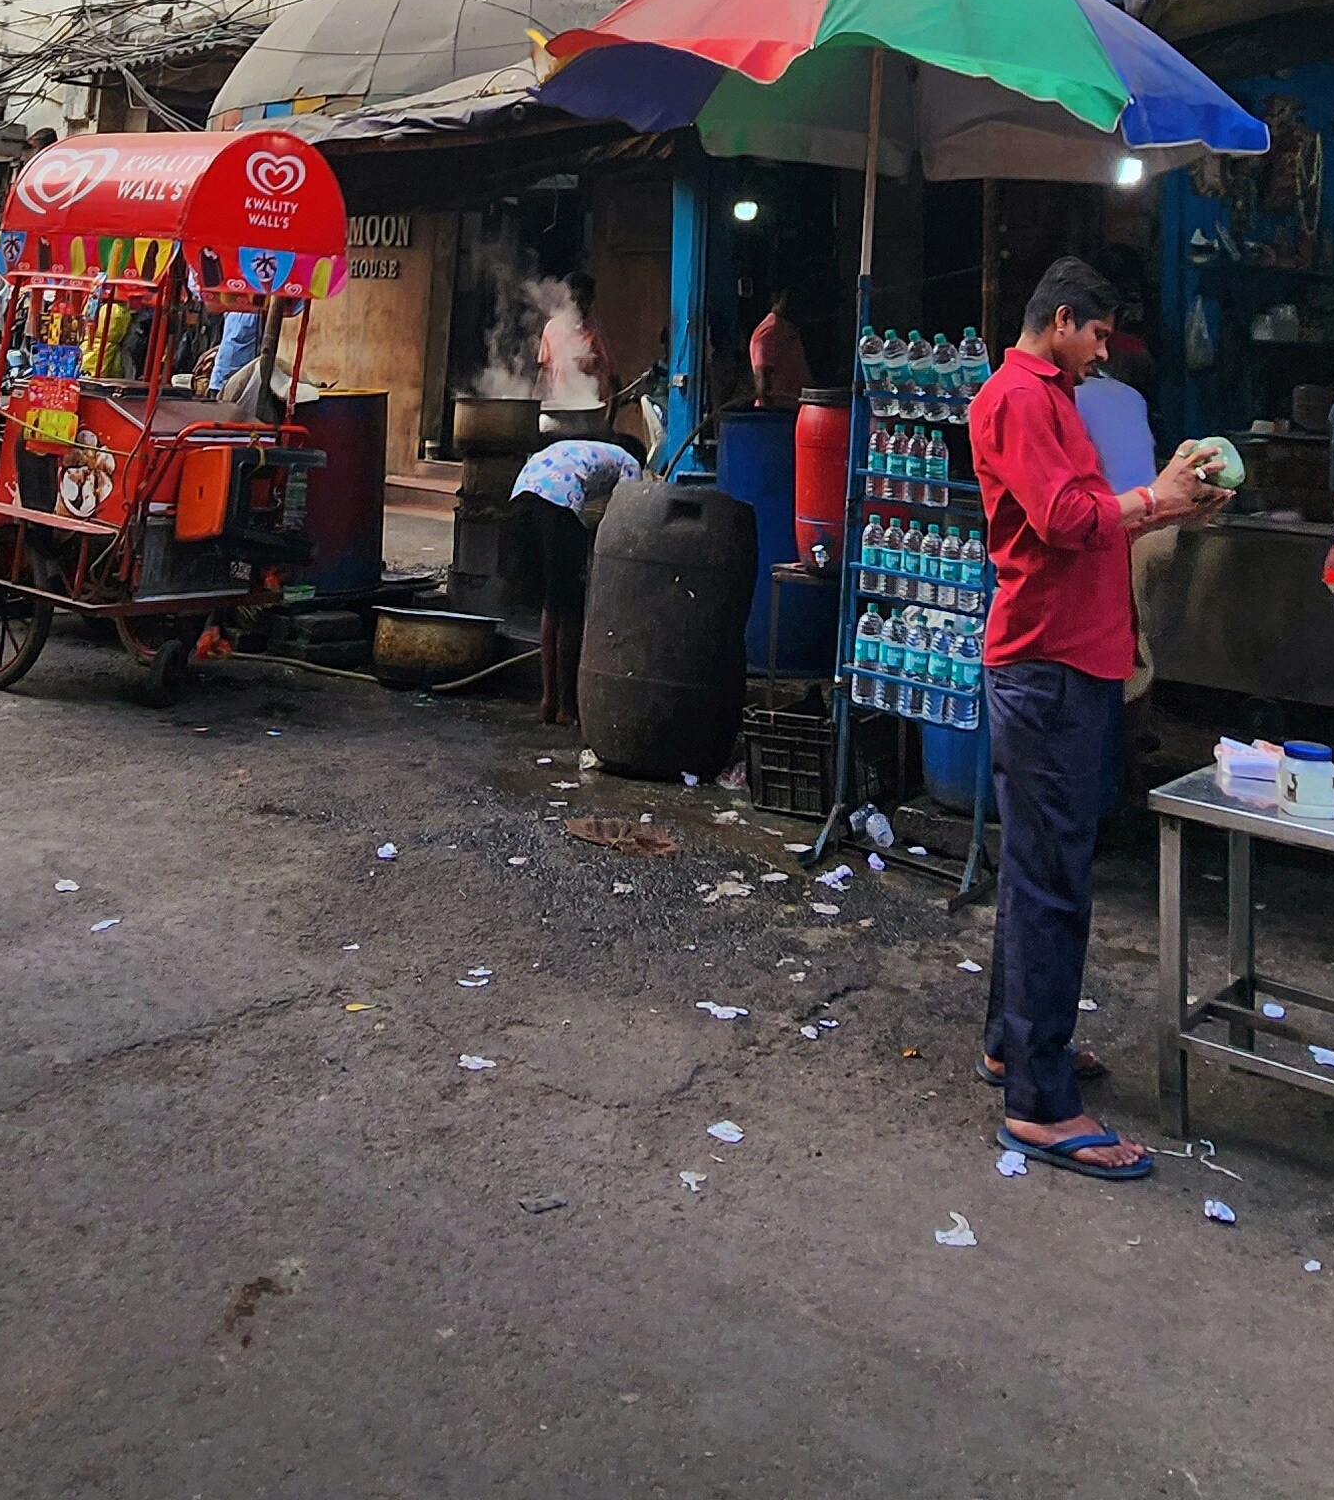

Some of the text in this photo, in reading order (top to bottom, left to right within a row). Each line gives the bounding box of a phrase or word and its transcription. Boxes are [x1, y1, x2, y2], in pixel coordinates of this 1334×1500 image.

[122, 152, 210, 172] KWALITY
[117, 179, 186, 200] WALL'S
[244, 196, 299, 215] KWALITY
[248, 213, 290, 229] WALL'S
[347, 214, 411, 247] MOON
[349, 259, 398, 278] HOUSE
